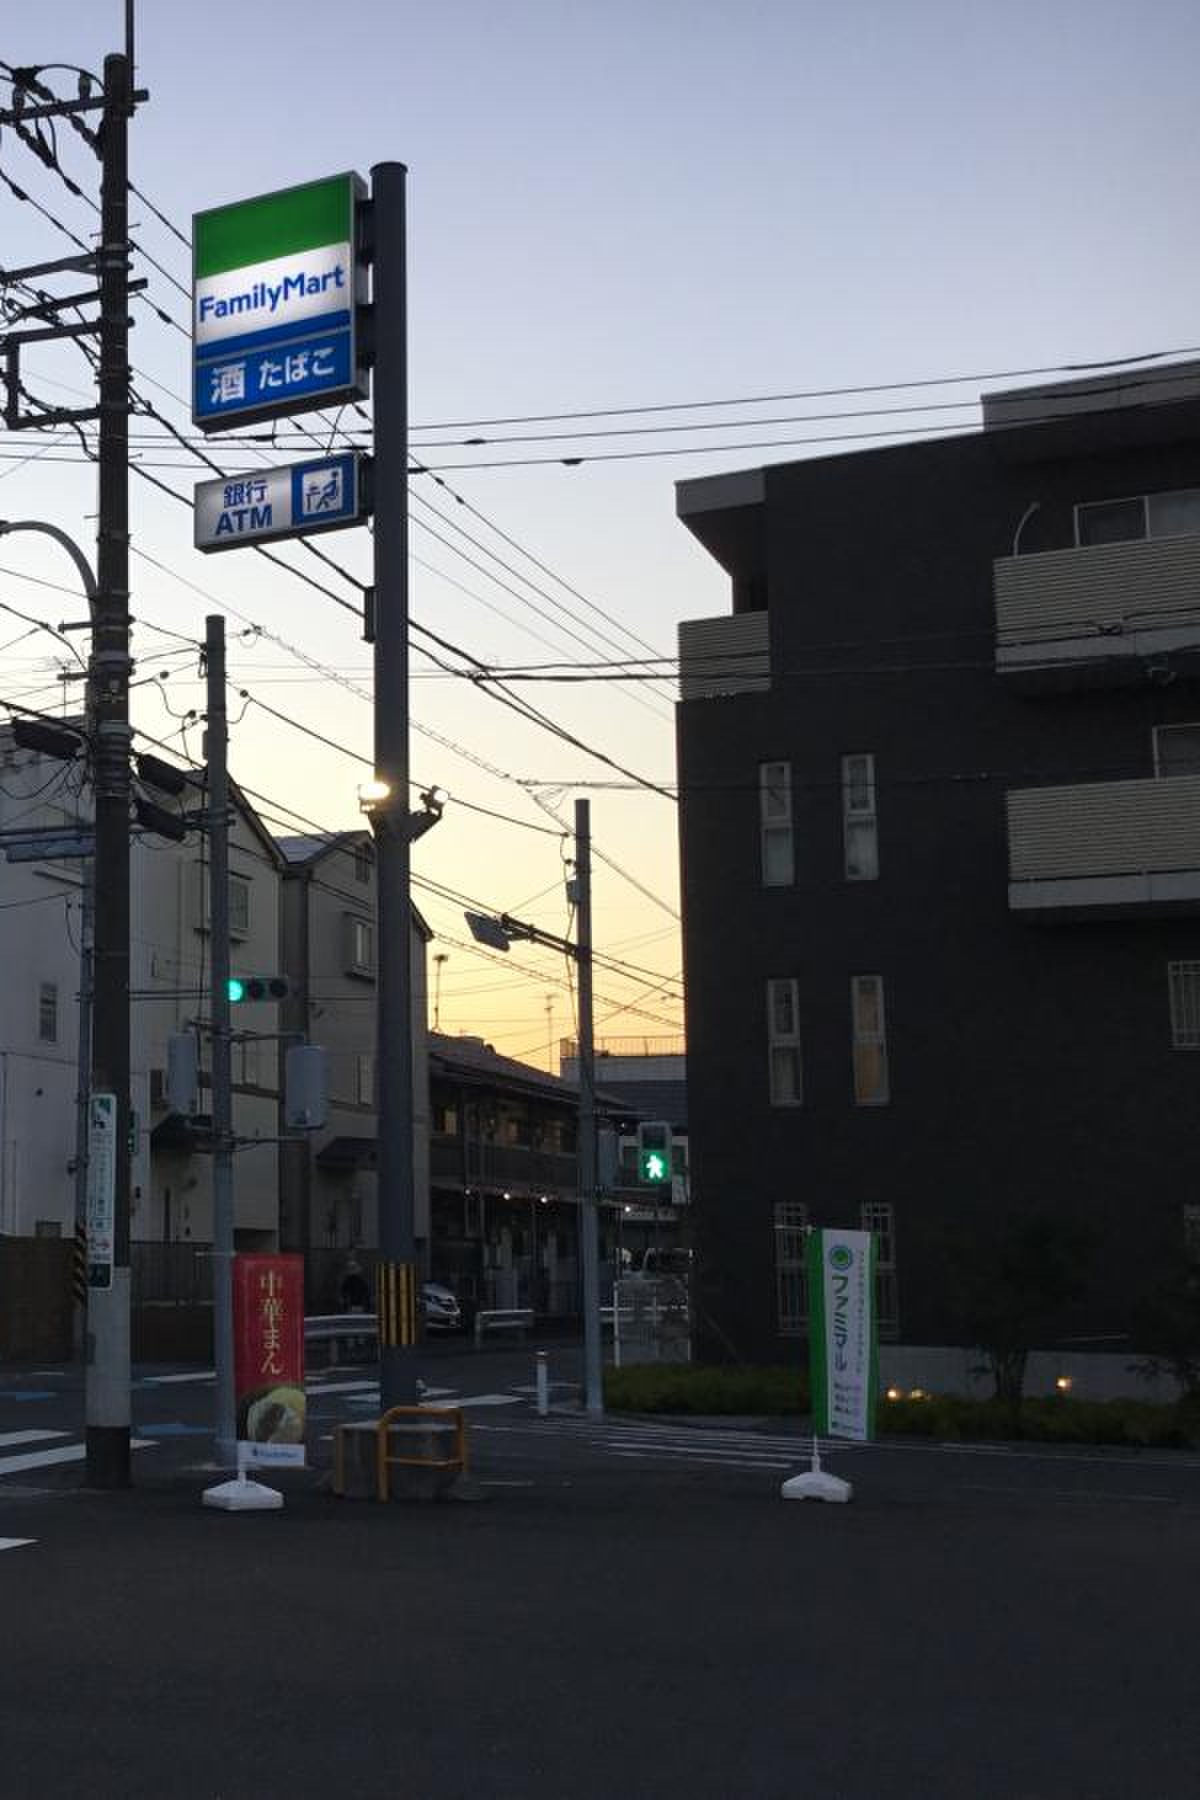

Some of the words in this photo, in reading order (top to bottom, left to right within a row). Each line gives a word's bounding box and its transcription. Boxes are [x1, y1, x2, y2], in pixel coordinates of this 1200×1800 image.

[199, 265, 344, 322] FamilyMart
[210, 362, 246, 403] 酒
[259, 347, 335, 390] たばこ
[215, 503, 273, 536] ATM
[224, 478, 269, 509] 銀行
[257, 1269, 287, 1376] 中華まん
